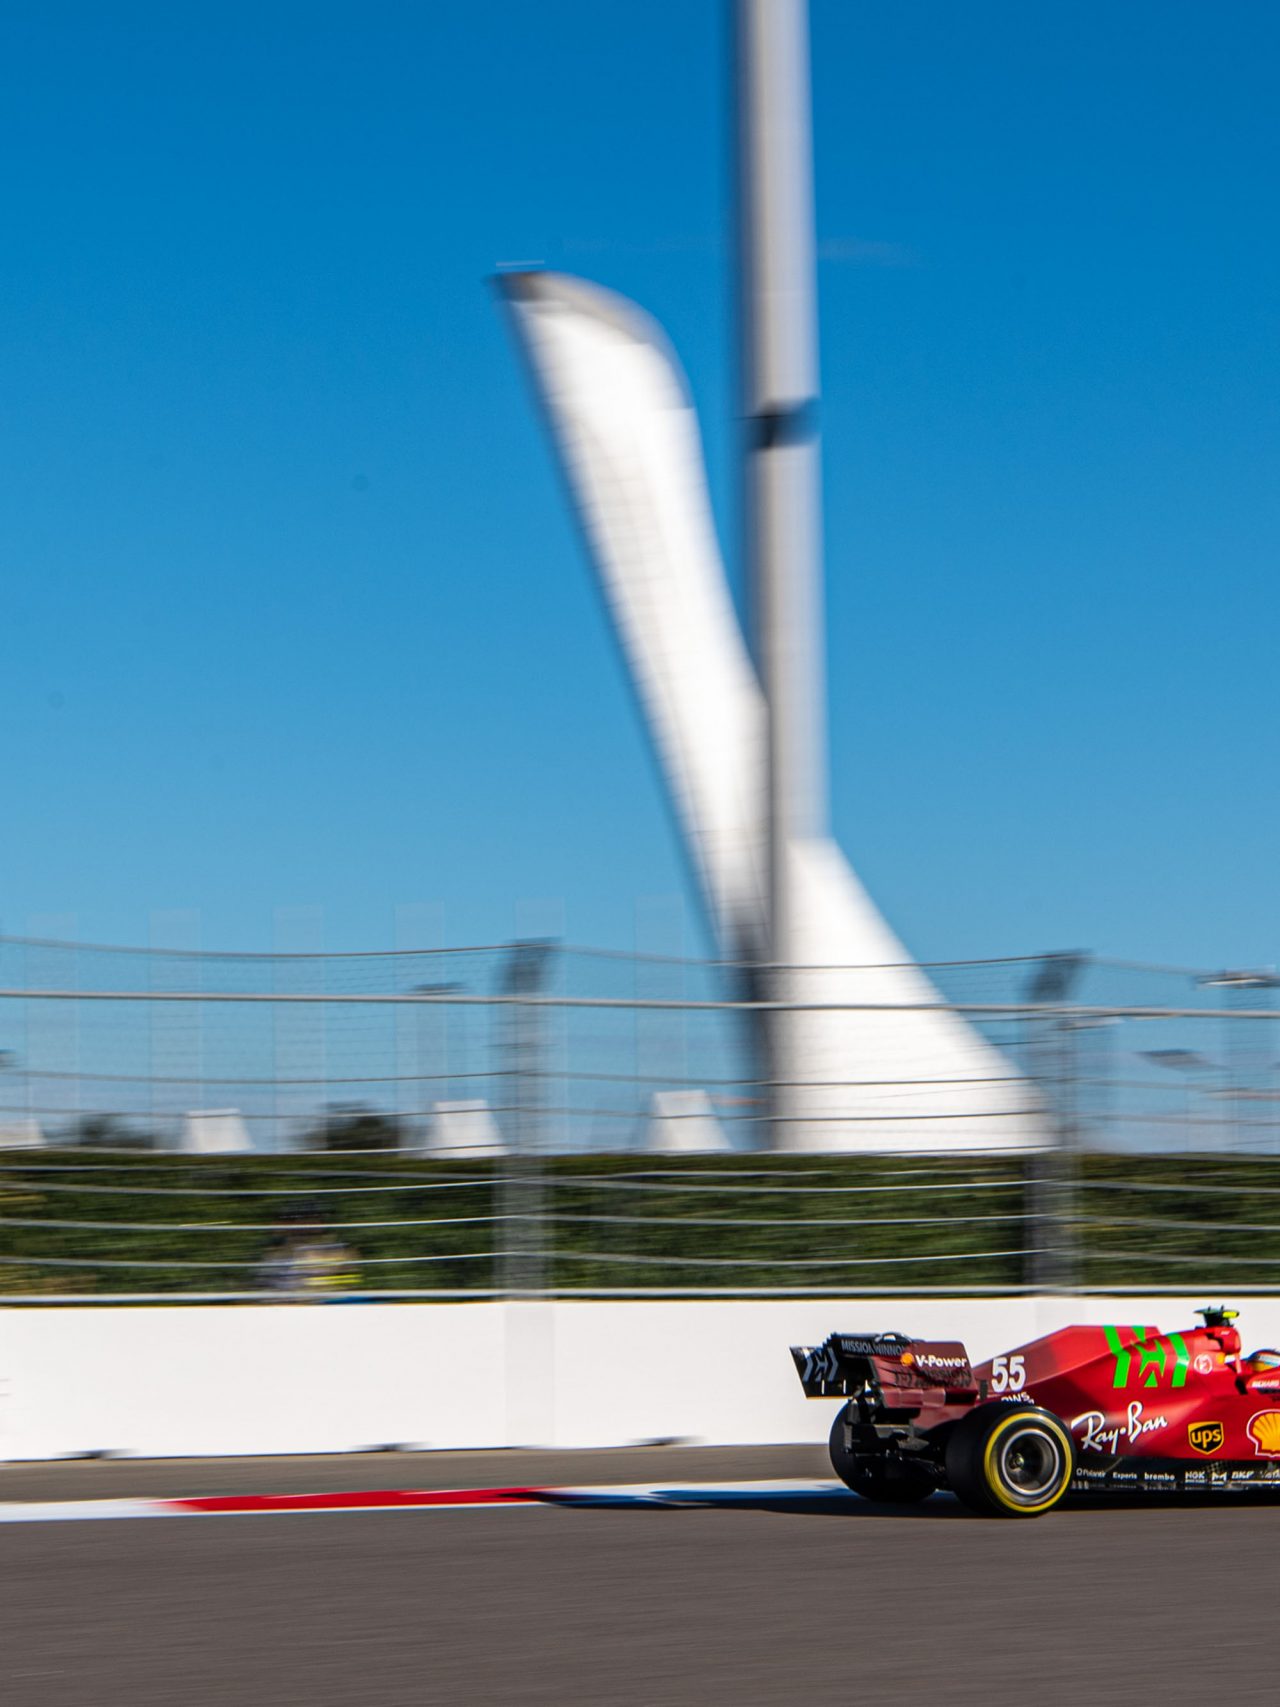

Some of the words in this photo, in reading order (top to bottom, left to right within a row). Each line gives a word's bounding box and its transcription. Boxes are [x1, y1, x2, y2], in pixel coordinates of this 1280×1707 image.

[915, 1354, 967, 1367] V-Power
[991, 1355, 1026, 1393] 55
[1191, 1429, 1221, 1449] ups
[1144, 1472, 1175, 1481] brembo
